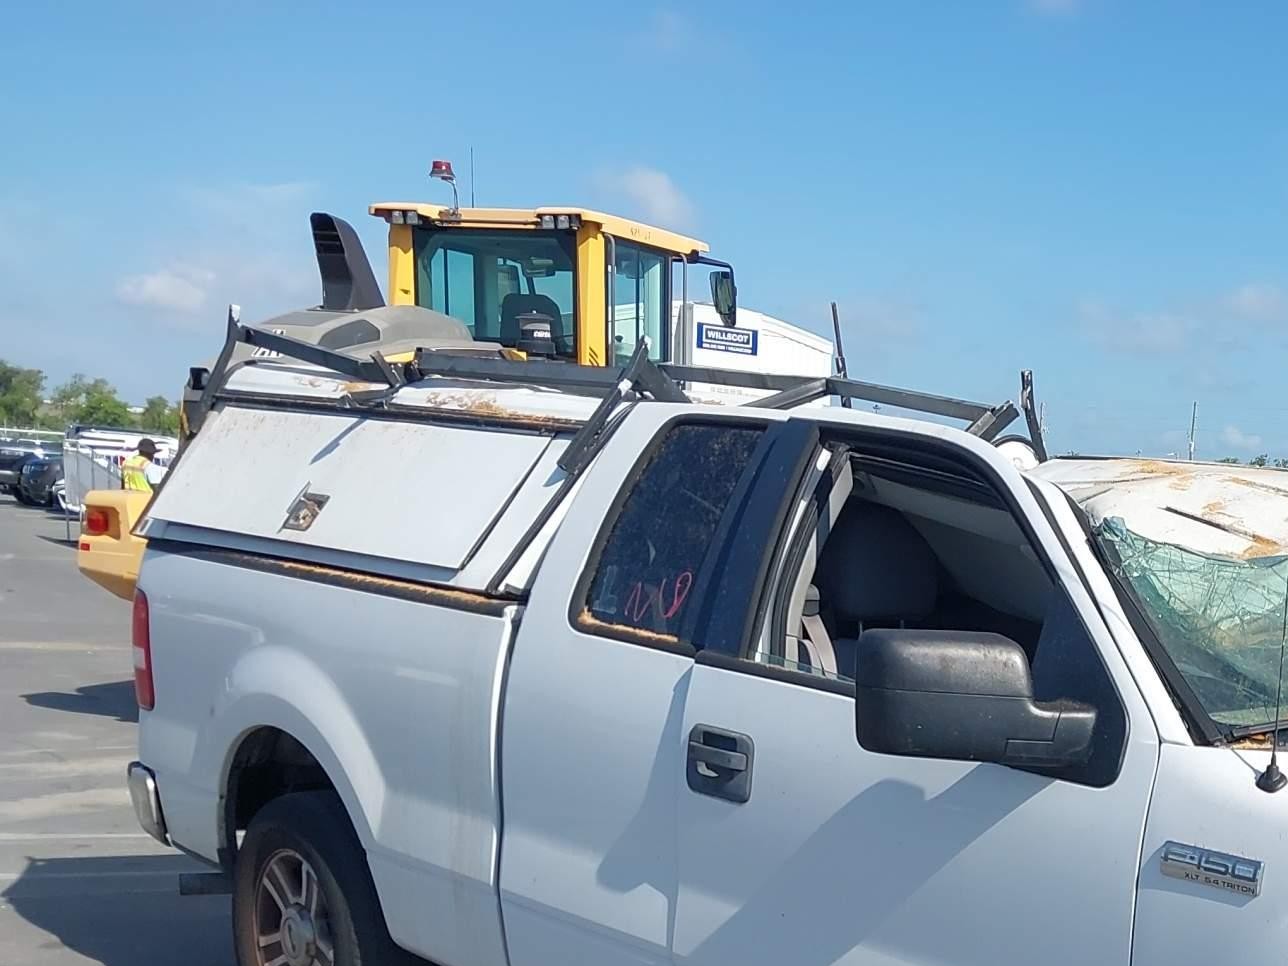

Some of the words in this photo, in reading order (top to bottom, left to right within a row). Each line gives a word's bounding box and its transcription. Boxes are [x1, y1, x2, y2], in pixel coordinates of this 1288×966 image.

[706, 329, 749, 344] WILLSCOT
[1184, 871, 1200, 881] XLT
[1221, 880, 1256, 895] TRITON
